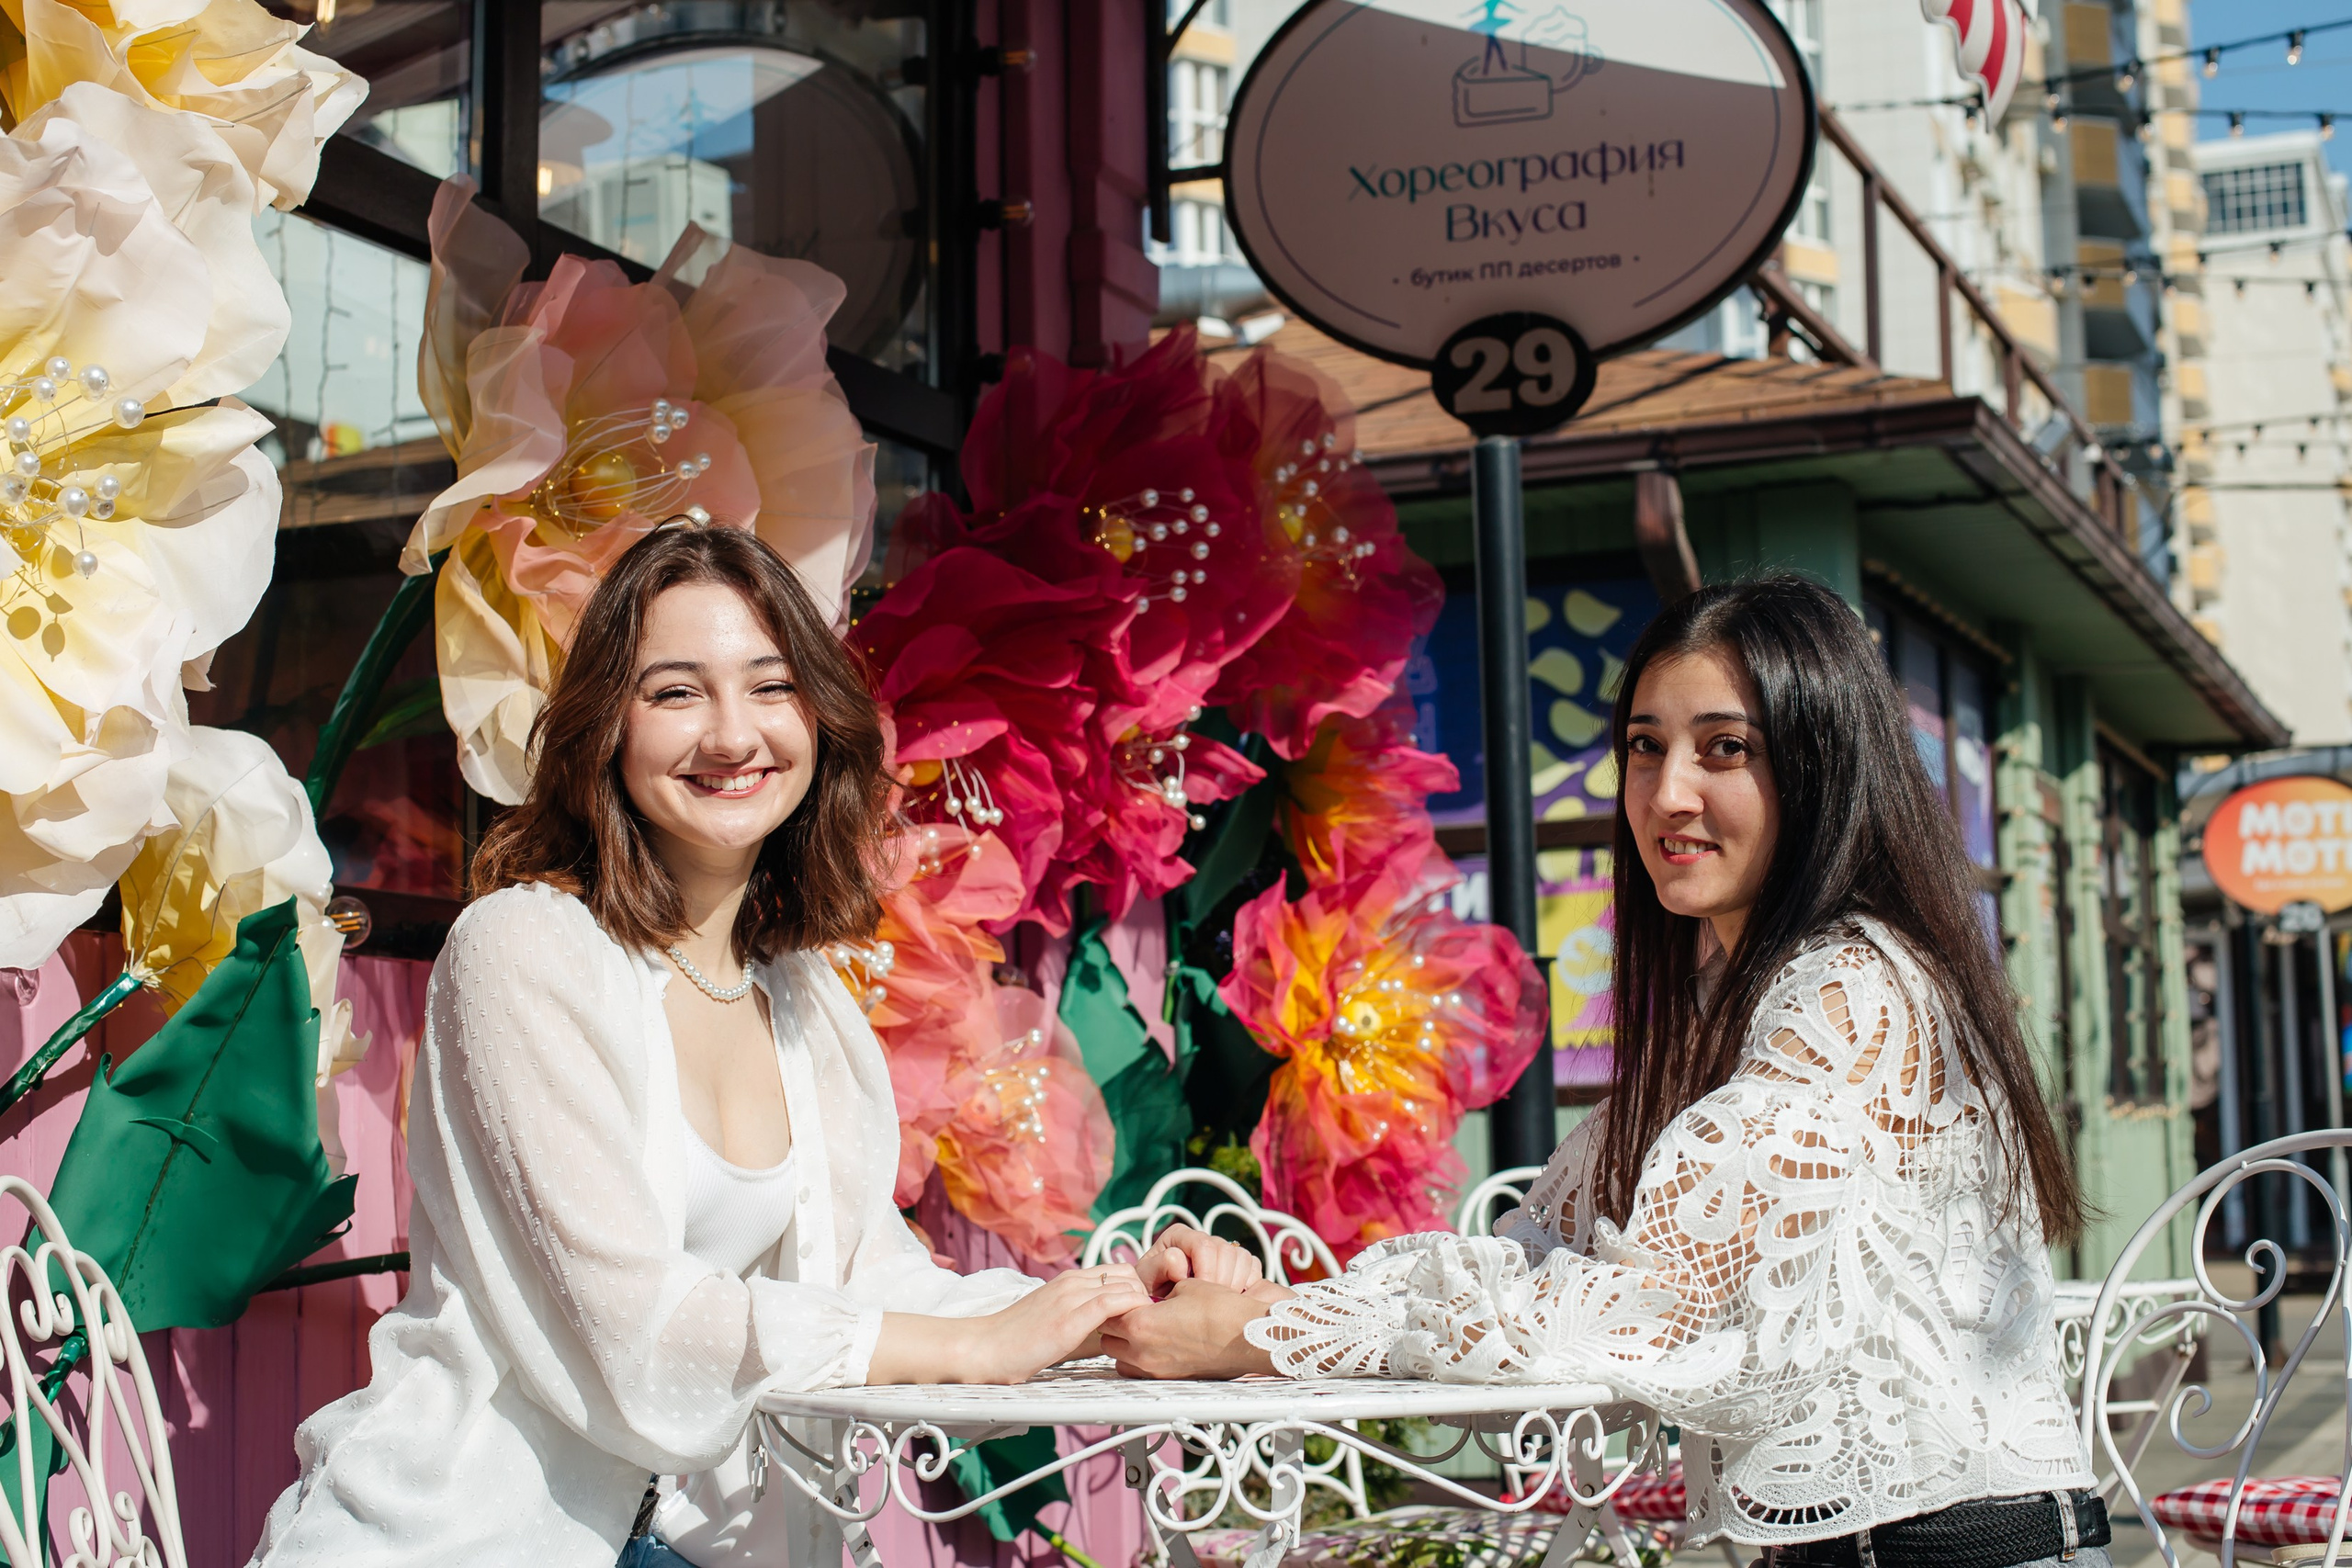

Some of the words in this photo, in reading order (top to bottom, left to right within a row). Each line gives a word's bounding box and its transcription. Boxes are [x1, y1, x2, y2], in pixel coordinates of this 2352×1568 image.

[1348, 140, 1684, 204] Хореография
[1446, 200, 1588, 245] Вкуса
[1409, 267, 1475, 288] бутик
[1479, 261, 1513, 280] ПП
[1516, 254, 1623, 280] десертов
[1450, 326, 1578, 414] 29
[2238, 799, 2352, 838] МОТ
[2240, 837, 2352, 876] МОТ
